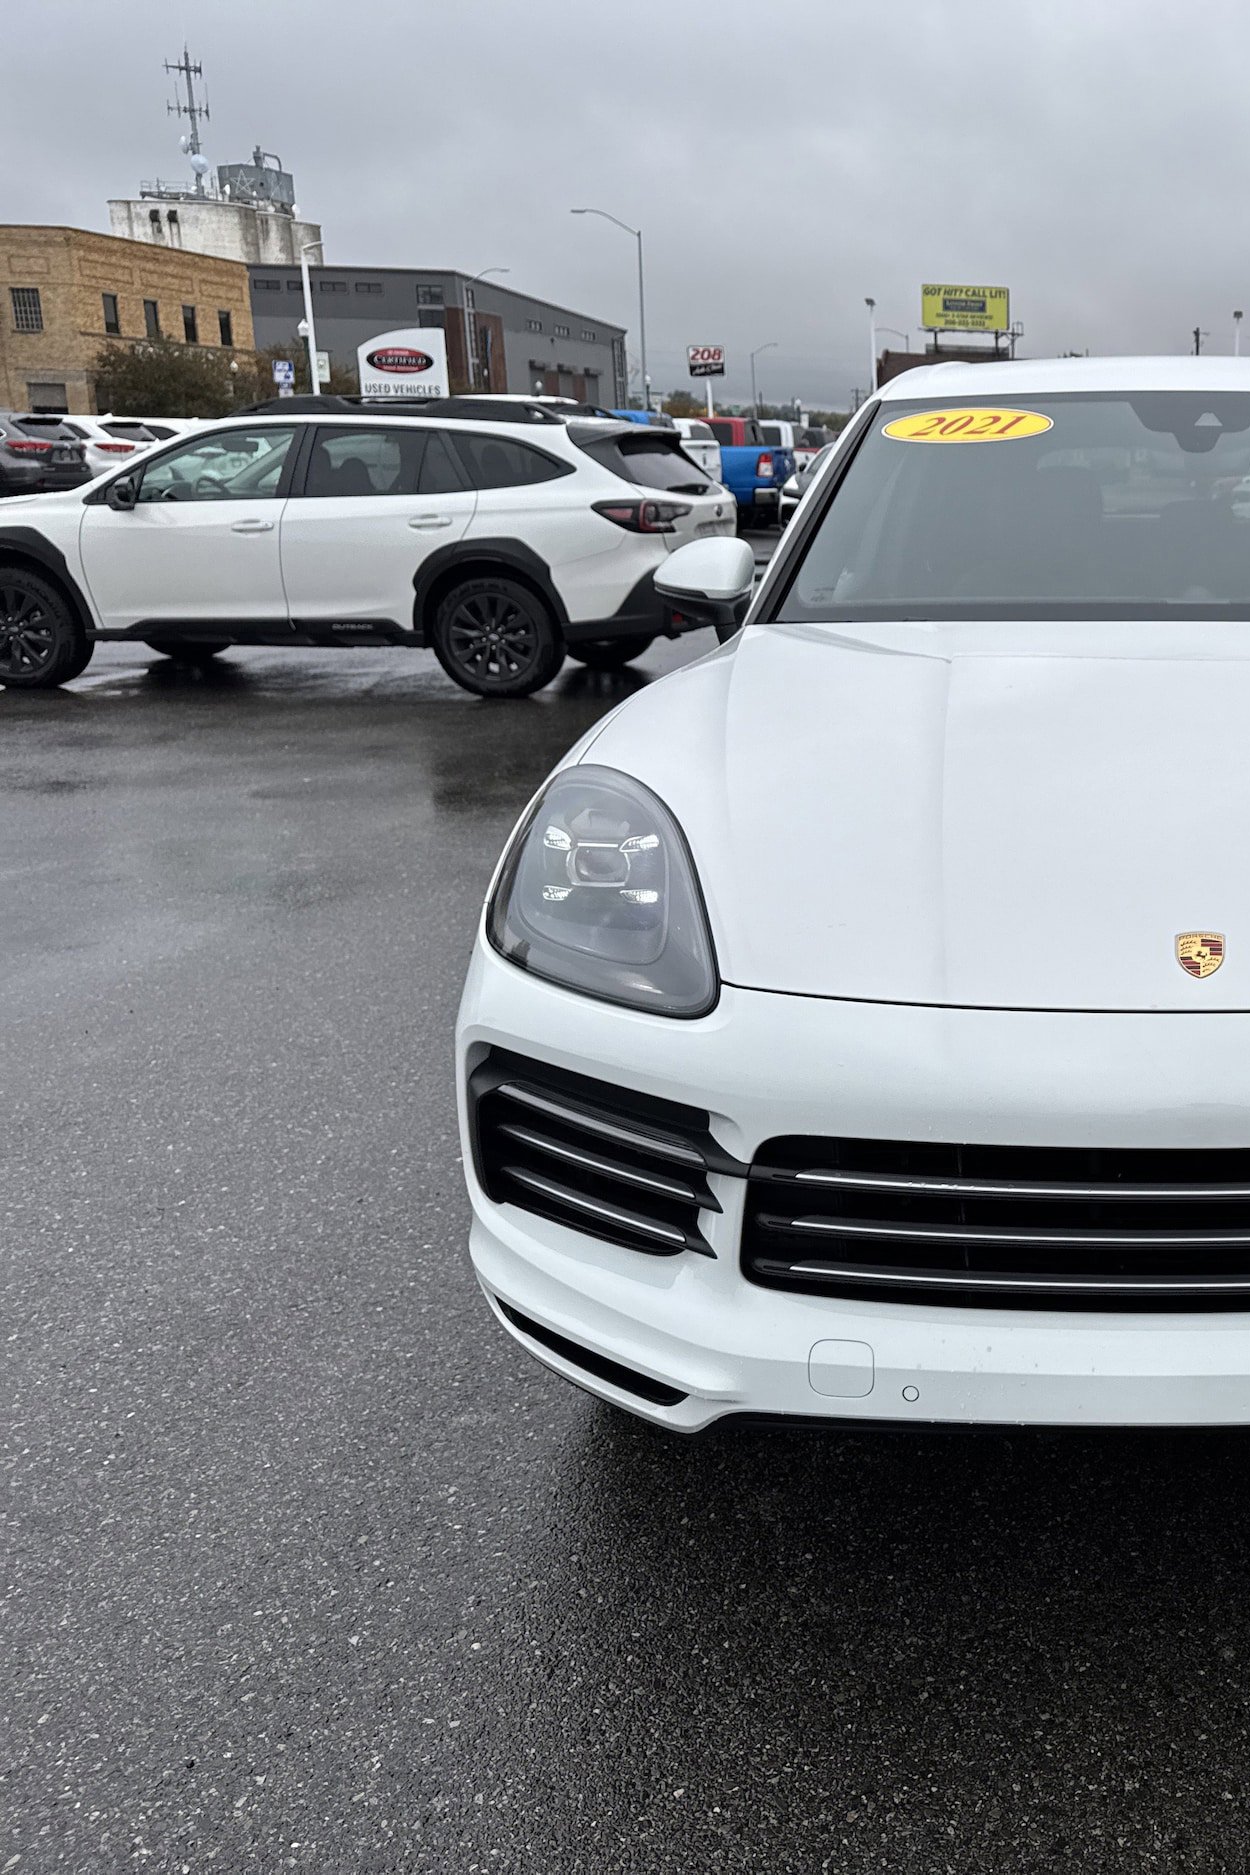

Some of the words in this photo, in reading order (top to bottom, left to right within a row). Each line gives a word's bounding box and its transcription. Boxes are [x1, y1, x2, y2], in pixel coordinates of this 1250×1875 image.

[923, 287, 942, 296] GOT
[964, 289, 987, 298] CALL
[691, 348, 722, 361] 208
[364, 383, 391, 394] USED
[392, 384, 442, 396] VEHICLES
[908, 415, 1028, 437] 2021
